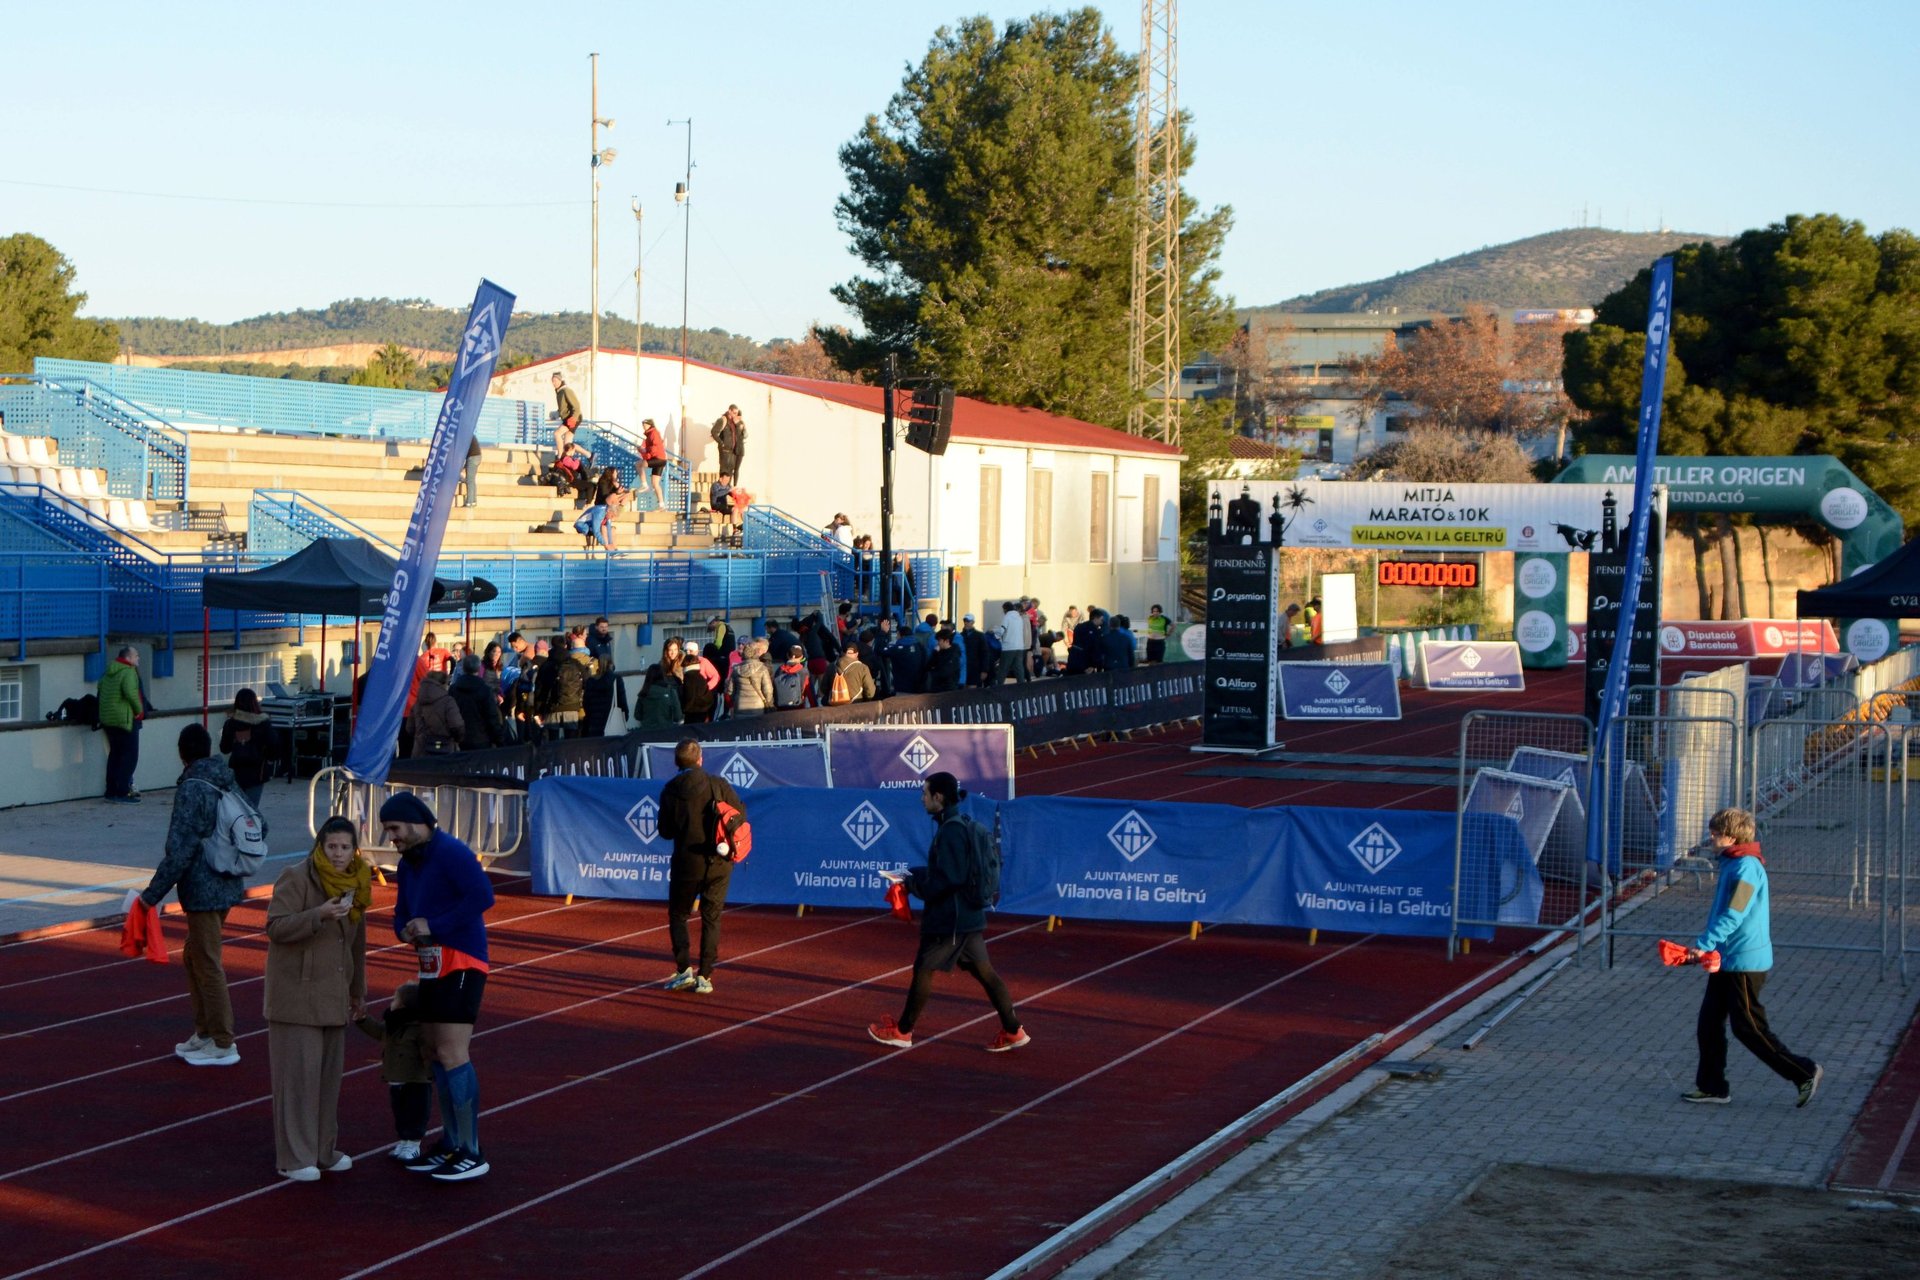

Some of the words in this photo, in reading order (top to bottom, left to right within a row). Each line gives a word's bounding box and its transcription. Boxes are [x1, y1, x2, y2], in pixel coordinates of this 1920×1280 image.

[413, 397, 456, 514] Vilanova
[1603, 466, 1714, 484] AMTLLER
[1720, 466, 1805, 486] ORIGEN
[1403, 488, 1455, 502] MITJA
[1369, 503, 1445, 521] MARATÓ
[1447, 511, 1455, 521] &
[1460, 507, 1489, 521] 10K
[1355, 529, 1422, 542] VILANOVA
[1435, 531, 1449, 542] LA
[1454, 527, 1504, 543] GELTRÚ
[400, 537, 417, 561] la
[1214, 559, 1266, 568] PENDENNIS
[1226, 592, 1266, 602] prysmian
[375, 569, 409, 661] Geltrú
[1210, 620, 1266, 629] EVASION
[1688, 630, 1736, 641] Diputació
[1690, 640, 1738, 650] Barcelona
[1228, 678, 1257, 688] Alfaro
[1440, 677, 1472, 685] Vilanova
[1485, 677, 1509, 685] Geltrú
[1064, 687, 1107, 710] EVASION
[1114, 682, 1152, 706] EVASION
[952, 702, 1003, 724] EVASION
[1011, 693, 1058, 720] EVASION
[1221, 705, 1252, 714] LITUSA
[1300, 704, 1339, 714] Vilanova
[1344, 705, 1353, 713] la
[1354, 704, 1383, 714] Geltrú
[603, 851, 672, 864] AJUNTAMENT
[820, 859, 891, 871] AJUNTAMENT
[578, 862, 639, 880] Vilanova
[650, 866, 662, 881] la
[1084, 870, 1160, 883] AJUNTAMENT
[1163, 873, 1179, 884] DE
[794, 871, 857, 887] Vilanova
[868, 873, 881, 889] la
[1056, 882, 1123, 900] Vilanova
[1127, 885, 1132, 900] i
[1135, 886, 1150, 901] la
[1153, 886, 1207, 903] Geltrú
[1324, 881, 1404, 896] AJUNTAMENT
[1408, 886, 1424, 896] DE
[1295, 892, 1366, 912] Vilanova
[1370, 899, 1375, 913] i
[1378, 898, 1393, 914] la
[1397, 899, 1451, 917] Geltrú
